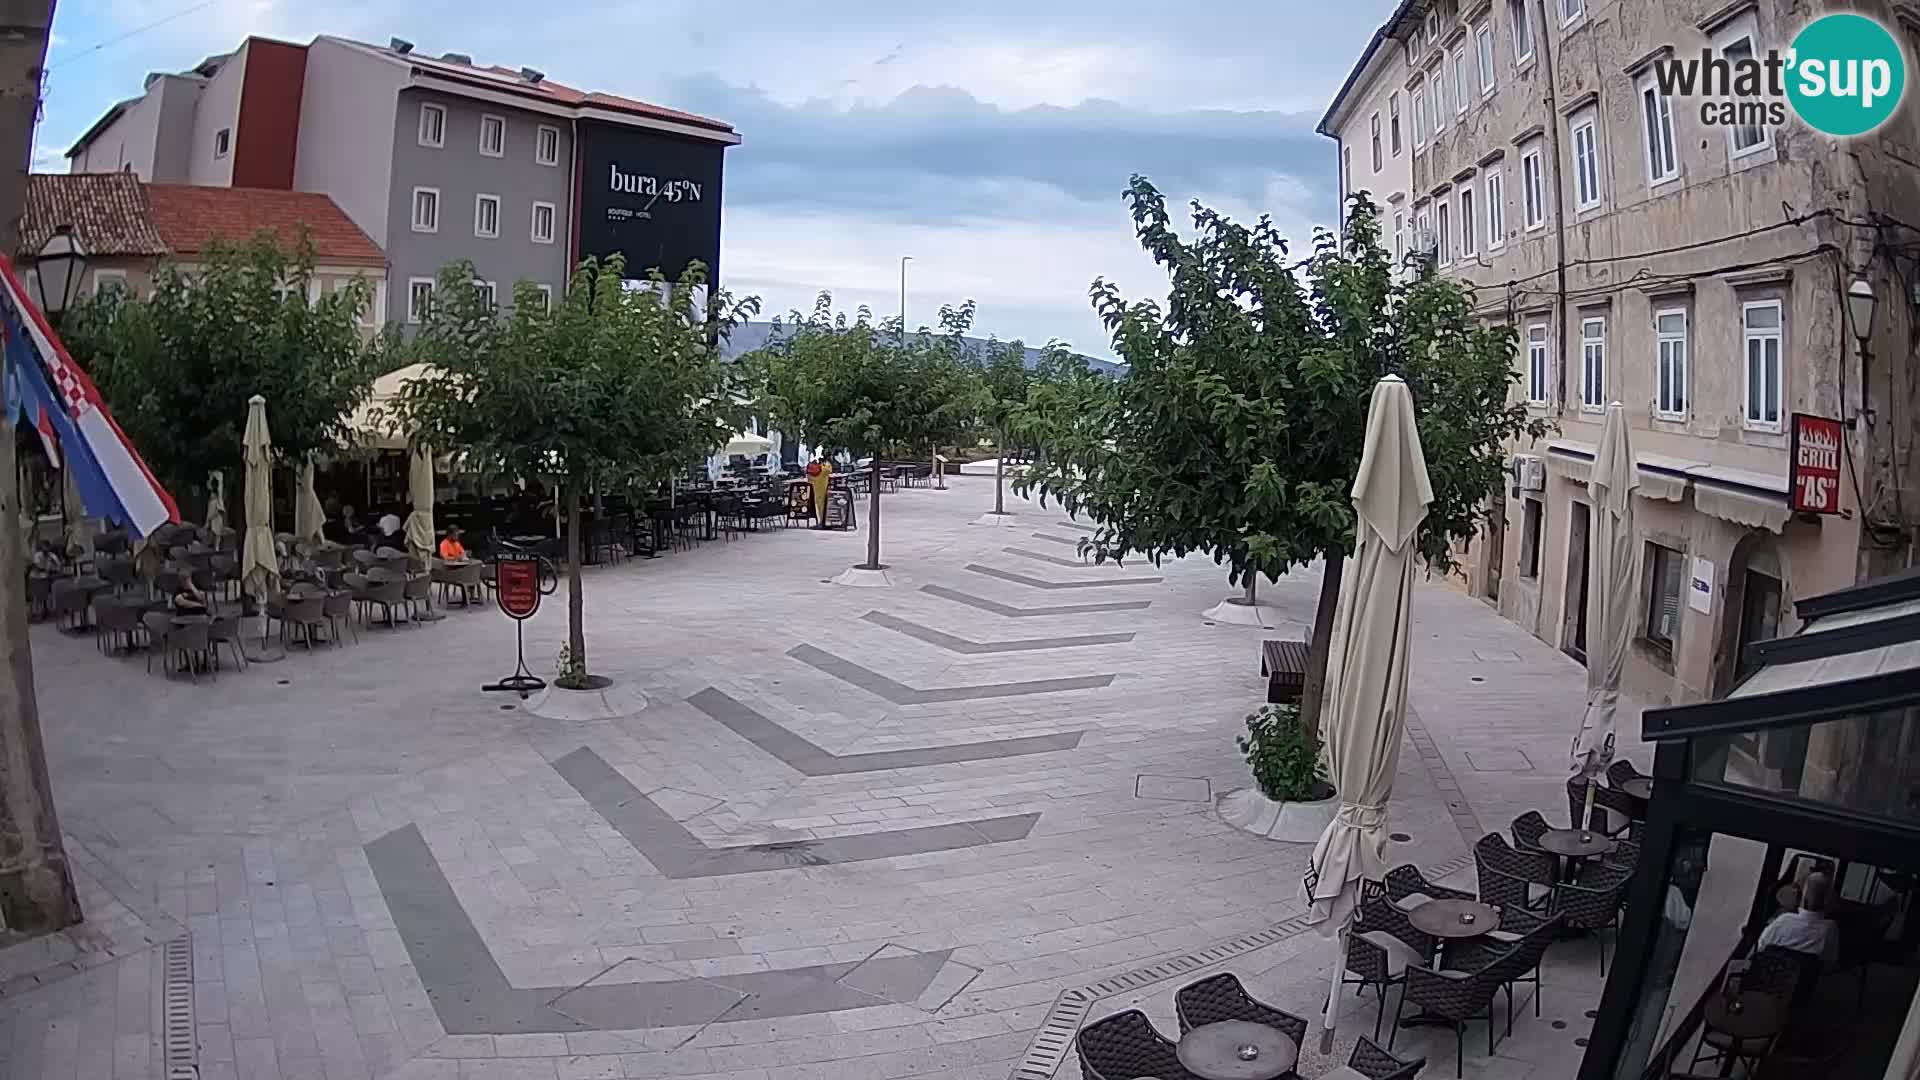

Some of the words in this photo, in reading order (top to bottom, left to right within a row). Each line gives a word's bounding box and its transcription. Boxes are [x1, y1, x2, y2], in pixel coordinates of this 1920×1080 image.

[1798, 446, 1838, 471] GRILL
[496, 553, 513, 561] WINE
[515, 553, 530, 561] BAR
